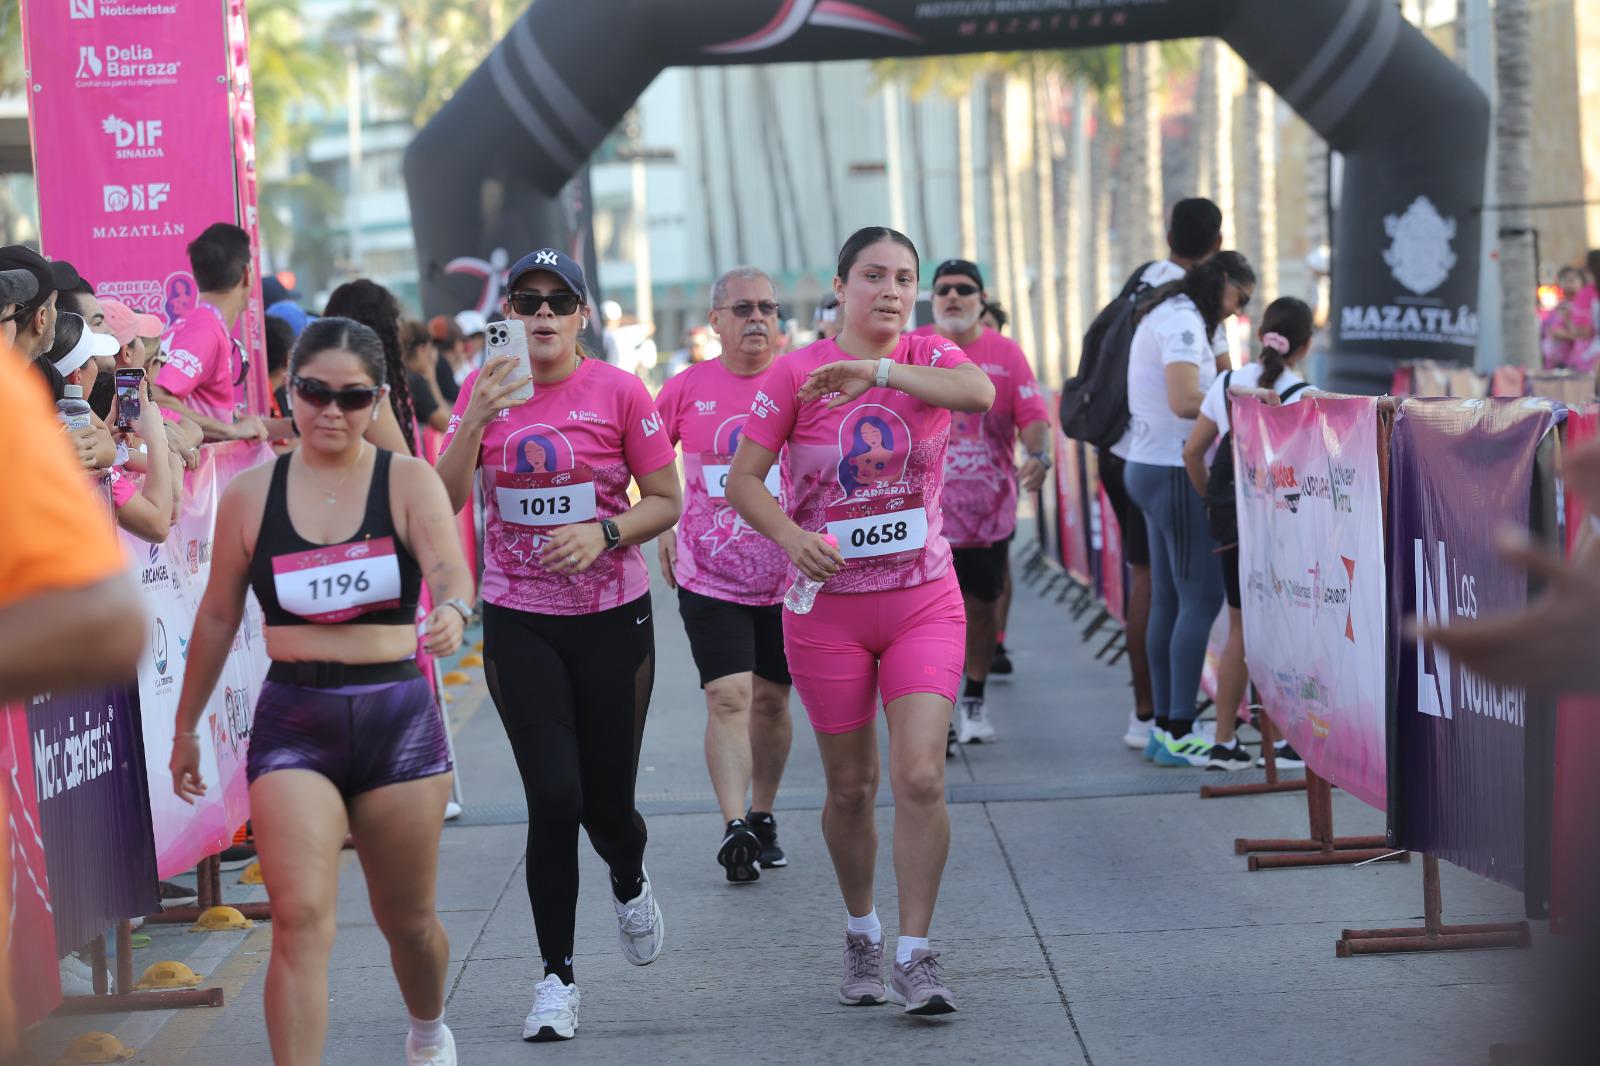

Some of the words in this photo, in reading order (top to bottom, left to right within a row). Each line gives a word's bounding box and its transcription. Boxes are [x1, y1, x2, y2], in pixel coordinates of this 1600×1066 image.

[100, 4, 177, 16] Noticieristas
[106, 44, 153, 61] Delia
[107, 60, 178, 77] Barraza
[114, 119, 163, 147] DIF
[115, 149, 164, 160] SINALOA
[103, 183, 171, 212] DIF
[98, 280, 162, 293] CARRERA
[697, 400, 717, 411] DIF
[854, 486, 906, 498] CARRERA
[519, 496, 571, 516] 1013
[851, 521, 908, 547] 0658
[142, 564, 169, 584] ARCANGEL
[308, 570, 370, 600] 1196
[1453, 557, 1477, 620] Los
